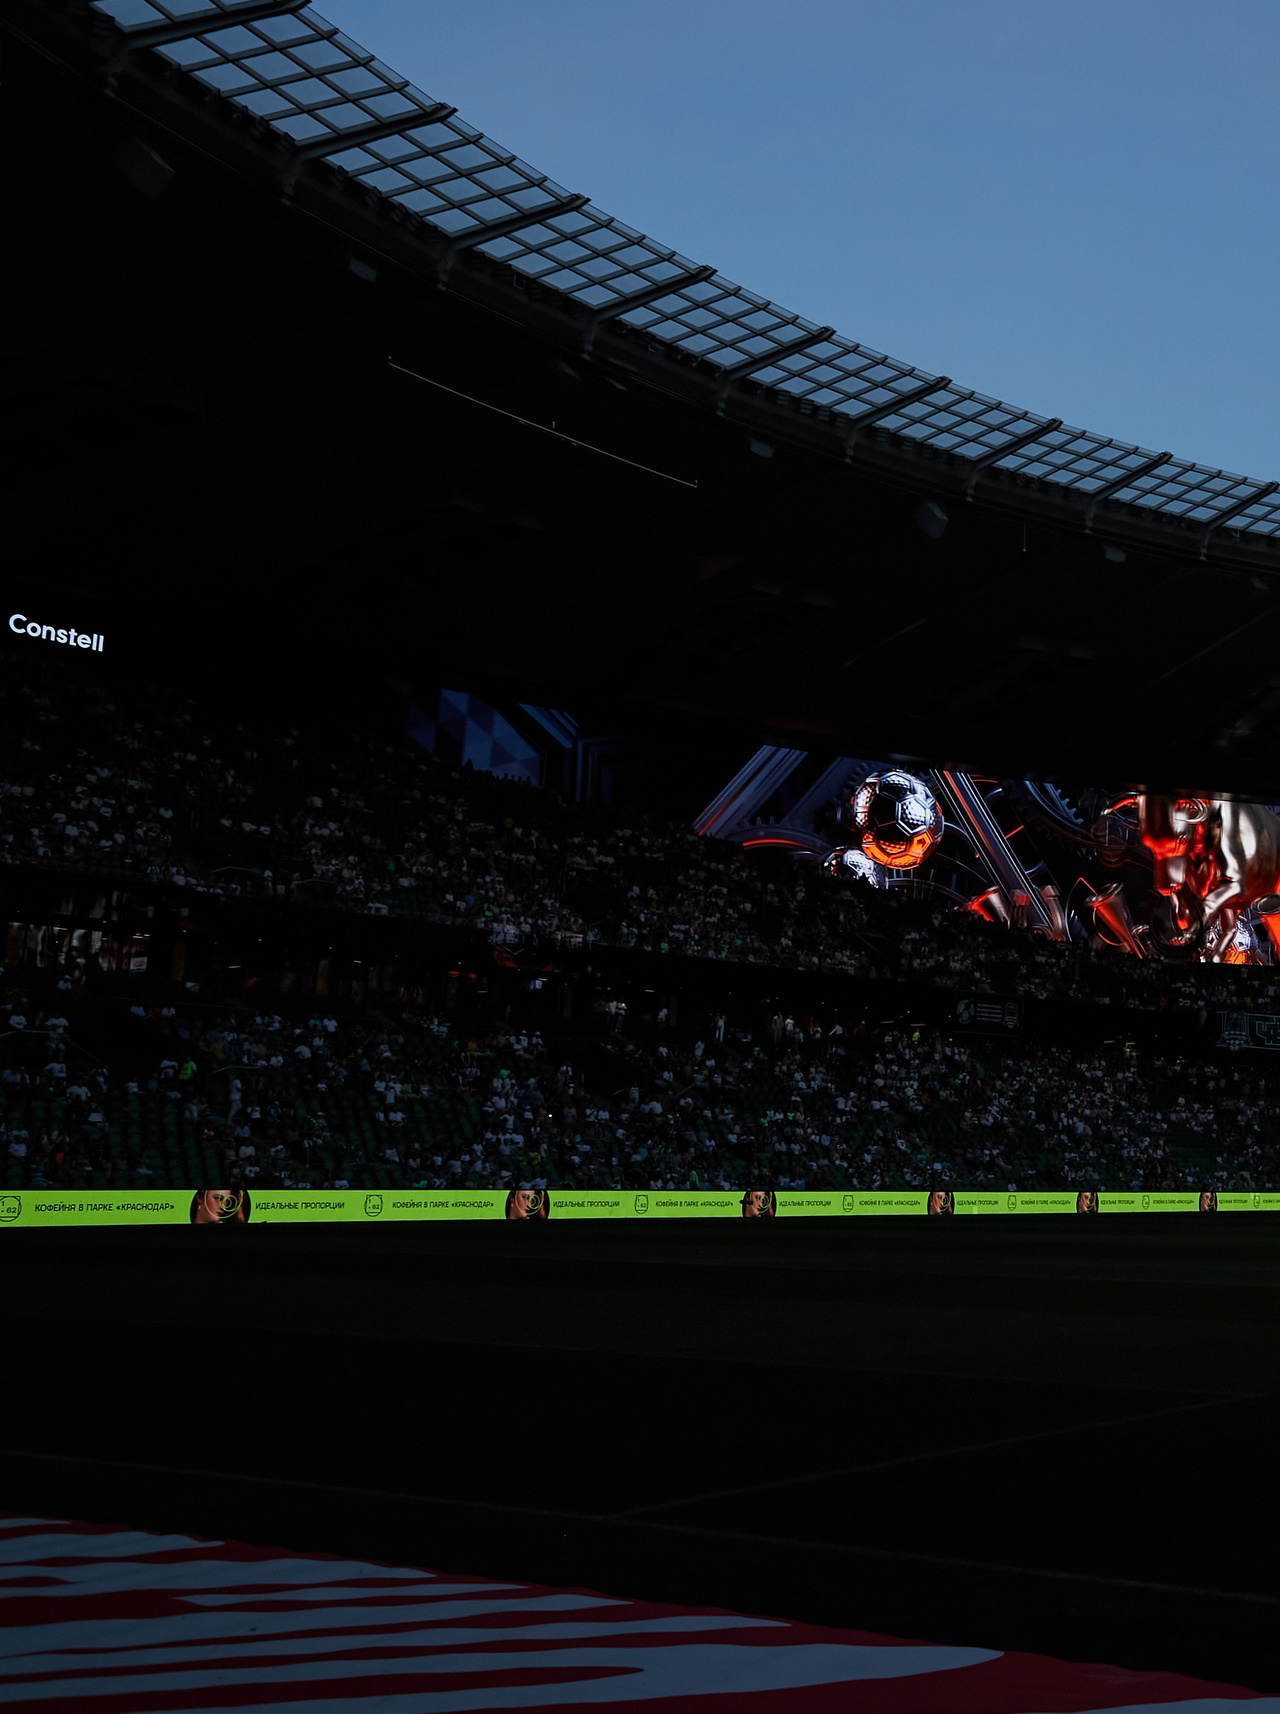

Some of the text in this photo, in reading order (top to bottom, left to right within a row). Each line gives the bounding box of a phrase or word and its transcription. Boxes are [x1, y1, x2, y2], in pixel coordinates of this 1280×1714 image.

[9, 613, 105, 652] Constell
[35, 1202, 174, 1212] КОФЕЙНЯ В ПАРКЕ «КРАСНОДАР»
[255, 1202, 345, 1210] ИДЕАЛЬНЫЕ ПРОПОРЦИИ
[392, 1199, 422, 1209] КОФЕЙНЯ
[451, 1201, 494, 1209] «КРАСНОДАР»
[553, 1200, 586, 1208] ИДЕАЛЬНЫЕ
